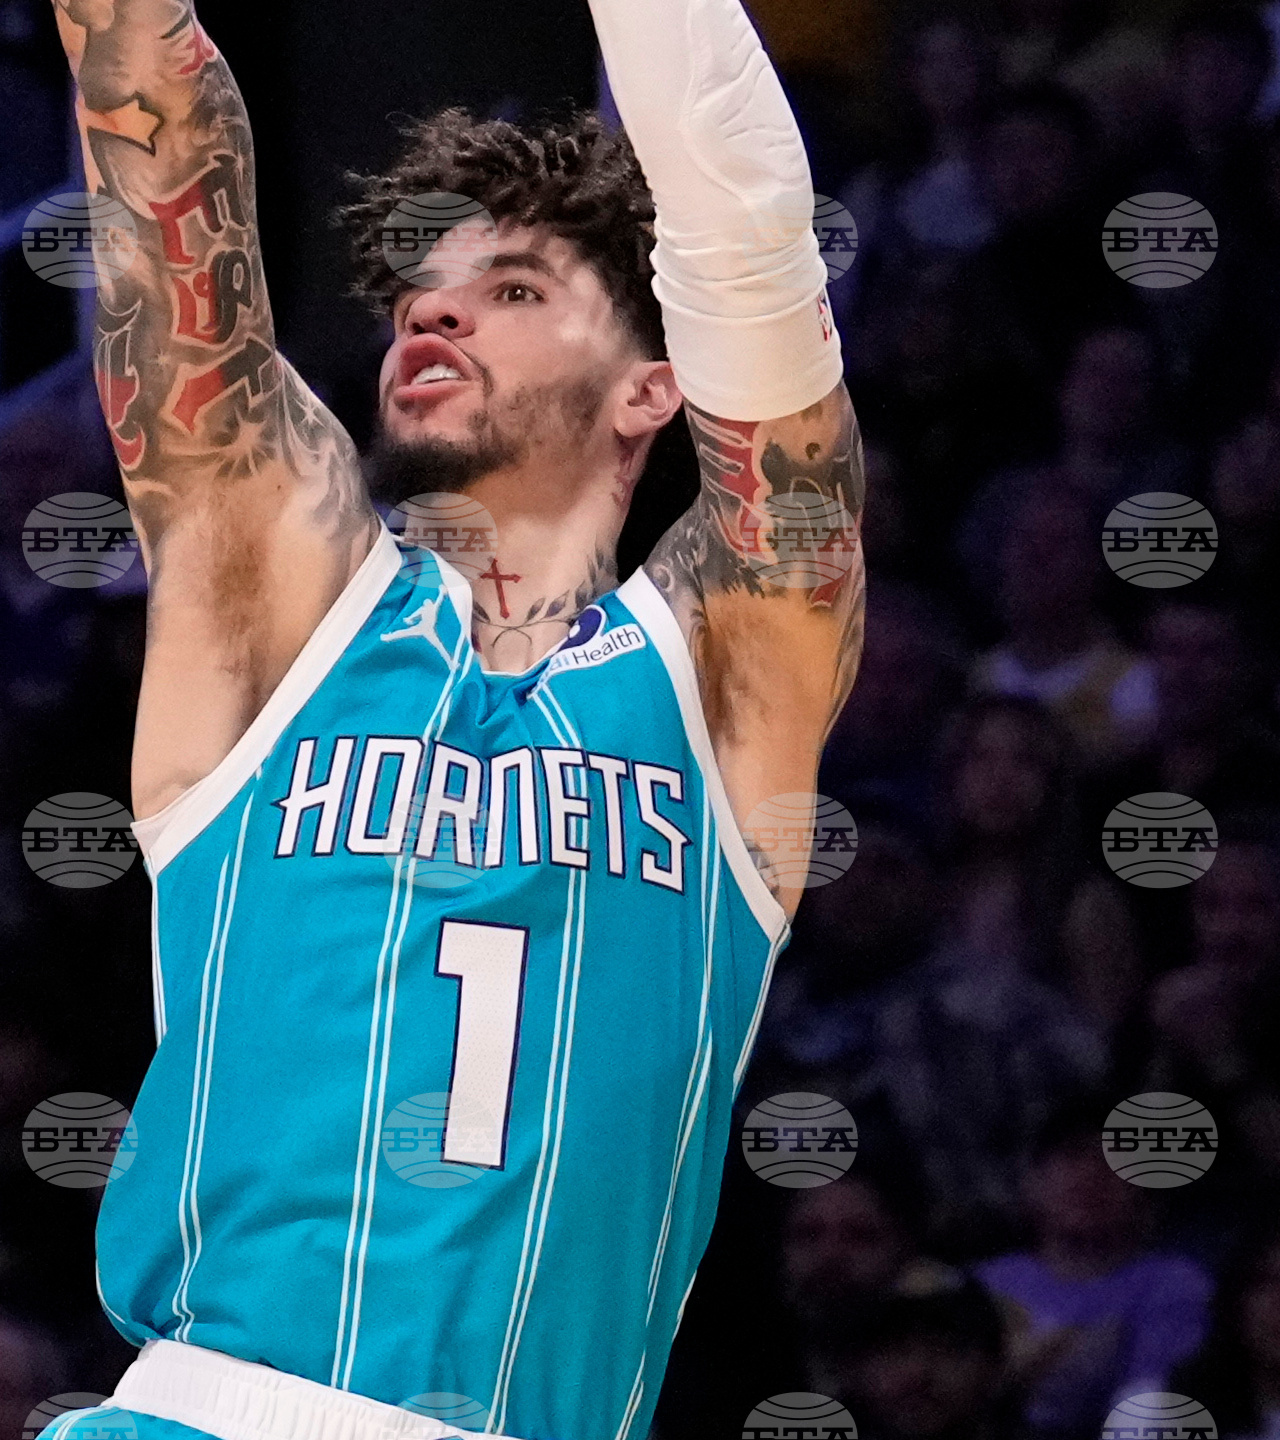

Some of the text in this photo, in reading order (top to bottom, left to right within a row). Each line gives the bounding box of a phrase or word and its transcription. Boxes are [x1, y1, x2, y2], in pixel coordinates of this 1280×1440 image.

[572, 627, 641, 665] Health
[271, 734, 692, 895] HORNETS
[433, 917, 530, 1171] 1
